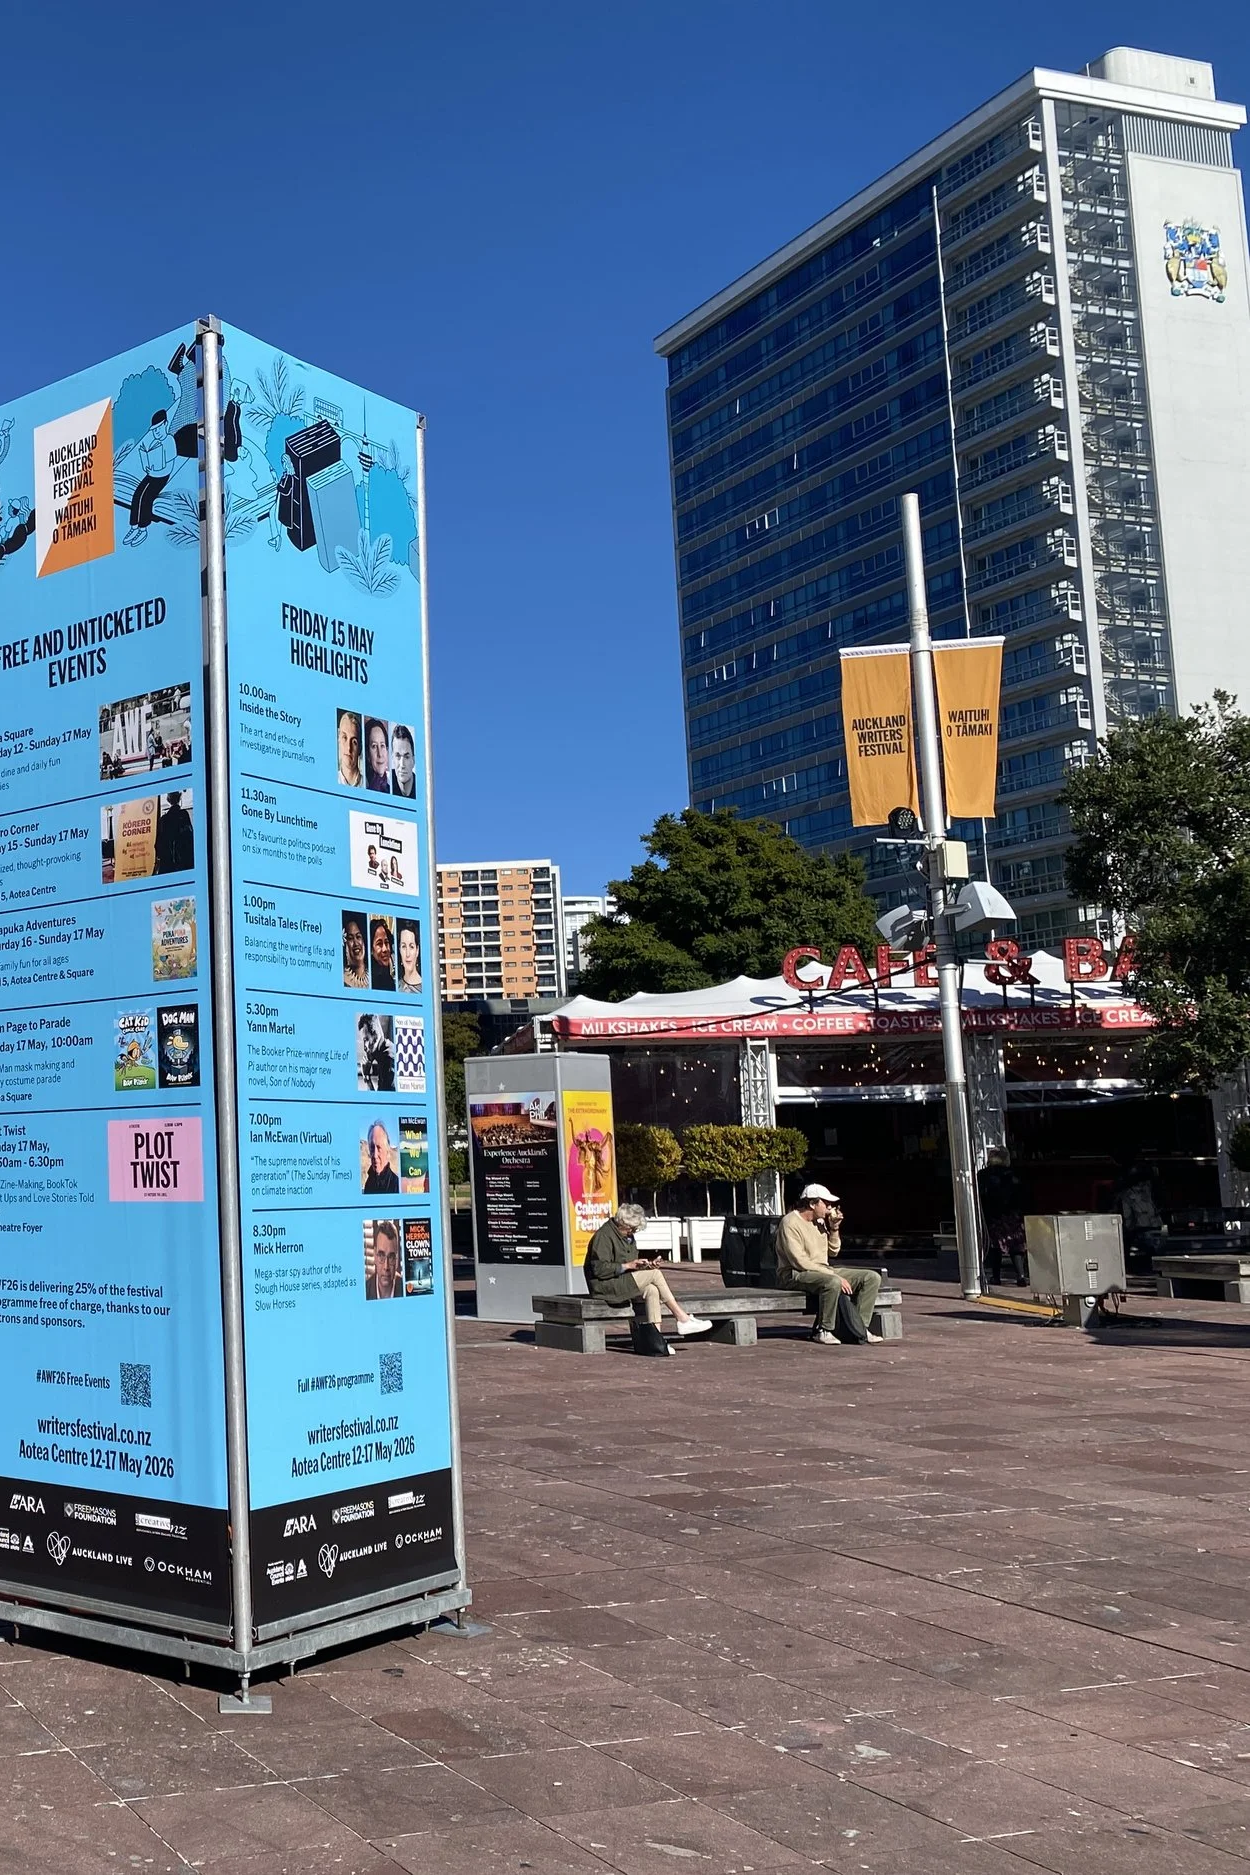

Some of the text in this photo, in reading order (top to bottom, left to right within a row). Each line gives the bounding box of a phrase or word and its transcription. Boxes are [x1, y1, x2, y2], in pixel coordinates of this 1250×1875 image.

[48, 434, 98, 467] AUCKLAND
[52, 455, 94, 483] WRITERS
[53, 474, 95, 500] FESTIVAL
[54, 496, 94, 525] WAITUHI
[52, 517, 97, 544] O TĀMAKI
[33, 629, 65, 658] AND
[68, 597, 167, 655] UNTICKETED
[282, 602, 374, 655] FRIDAY 15 MAY
[48, 647, 107, 688] EVENTS
[291, 637, 368, 685] HIGHLIGHTS
[239, 683, 276, 703] 10.00am
[240, 699, 301, 727] Inside the Story
[948, 709, 990, 723] WAITUHI
[852, 715, 905, 731] AUCKLAND
[947, 723, 992, 737] O TĀMAKI
[4, 727, 34, 742] Square
[14, 743, 23, 754] 12
[29, 736, 60, 751] Sunday
[62, 731, 72, 743] 17
[73, 728, 91, 740] May
[857, 729, 903, 744] WRITERS
[859, 742, 905, 757] FESTIVAL
[241, 788, 277, 805] 11.30am
[242, 804, 318, 830] Gone By Lunchtime
[10, 822, 39, 835] Corner
[8, 840, 18, 851] 15
[25, 834, 56, 848] Sunday
[59, 830, 68, 841] 17
[70, 828, 89, 839] May
[244, 895, 275, 911] 1.00pm
[26, 917, 76, 931] Adventures
[244, 912, 322, 935] Tusitala Tales (Free)
[22, 936, 32, 947] 16
[39, 932, 71, 945] Sunday
[74, 929, 83, 940] 17
[86, 927, 104, 939] May
[984, 938, 1041, 985] &
[1064, 936, 1142, 983] BA
[162, 1012, 195, 1025] DOG MAN
[246, 1003, 278, 1018] 5.30pm
[1106, 1008, 1154, 1024] CREA
[7, 1022, 27, 1034] Page
[29, 1021, 38, 1030] to
[40, 1017, 70, 1029] Parade
[247, 1020, 295, 1035] Yann Martel
[581, 1014, 942, 1036] MILKSHAKES ICE CREAM COFFEE TOASTIES
[17, 1040, 26, 1050] 17
[28, 1039, 48, 1051] May,
[51, 1035, 93, 1048] 10:00am
[249, 1113, 281, 1127] 7.00pm
[4, 1125, 26, 1136] Twist
[250, 1131, 332, 1144] Ian McEwan (Virtual)
[18, 1141, 27, 1151] 17
[30, 1140, 50, 1153] May,
[134, 1132, 174, 1159] PLOT
[29, 1156, 64, 1169] 6.30pm
[130, 1161, 179, 1188] TWIST
[23, 1223, 43, 1234] Foyer
[253, 1225, 286, 1238] 8.30pm
[254, 1242, 303, 1255] Mick Herron
[406, 1240, 430, 1249] CLOWN
[20, 1280, 27, 1291] is
[29, 1281, 73, 1296] delivering
[75, 1283, 97, 1295] 25%
[98, 1284, 108, 1295] of
[110, 1285, 125, 1296] the
[127, 1285, 163, 1298] festival
[39, 1298, 57, 1310] free
[59, 1299, 69, 1310] of
[70, 1300, 104, 1314] charge,
[106, 1301, 139, 1314] thanks
[141, 1304, 151, 1314] to
[154, 1306, 170, 1316] our
[255, 1299, 296, 1311] Slow Horses
[22, 1314, 38, 1325] and
[41, 1318, 85, 1328] sponsors.
[37, 1369, 110, 1389] #AWF26 Free Events
[298, 1372, 374, 1393] Full #AWF26 programme
[38, 1416, 151, 1446] writersfestival.co.nz
[308, 1415, 398, 1445] writersfestival.co.nz
[19, 1439, 174, 1478] Aotea Centre 12-17 May 2026
[292, 1435, 414, 1478] Aotea Centre 12-17 May 2026
[74, 1504, 116, 1517] FREEMASONS
[74, 1512, 116, 1526] FOUNDATION
[72, 1548, 132, 1566] AUCKLAND LIVE
[158, 1562, 212, 1581] OCKHAM
